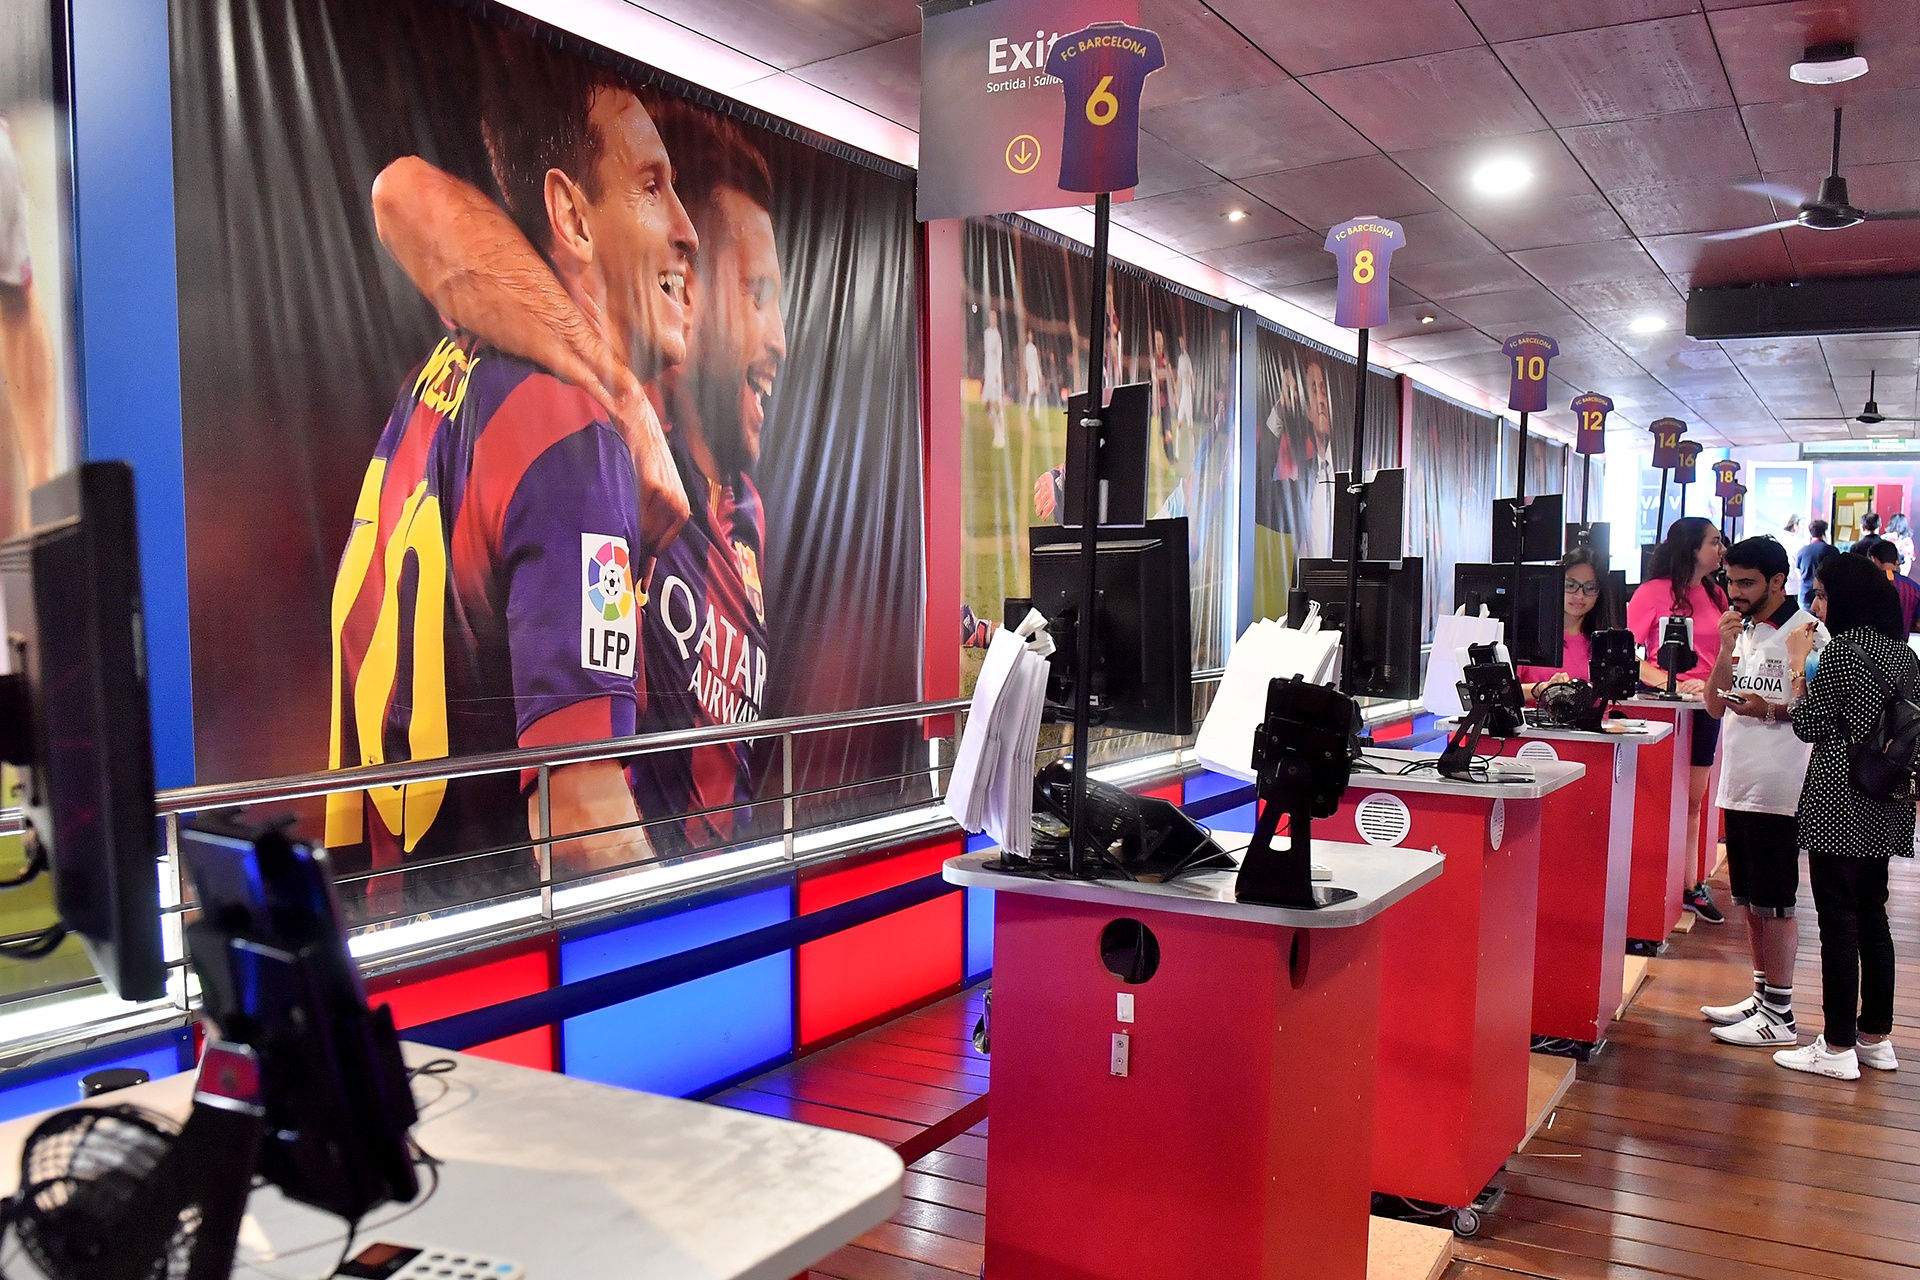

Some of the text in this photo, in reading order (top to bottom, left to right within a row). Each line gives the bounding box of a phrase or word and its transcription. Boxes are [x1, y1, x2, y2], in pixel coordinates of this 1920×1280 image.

[1061, 36, 1147, 61] FC BARCELONA
[986, 78, 1026, 93] Sortida
[1086, 76, 1118, 126] 6
[1335, 224, 1394, 241] FC BARCELONA
[1353, 250, 1375, 284] 8
[1518, 338, 1552, 350] BARCELONA
[1515, 356, 1545, 381] 10
[1582, 411, 1603, 430] 12
[1659, 433, 1676, 449] 14
[1679, 453, 1695, 467] 16
[1719, 470, 1733, 483] 18
[589, 628, 630, 670] LFP
[660, 575, 767, 711] QATAR
[325, 458, 449, 853] 10
[1732, 675, 1783, 692] RCELONA
[687, 660, 759, 740] AIRWA
